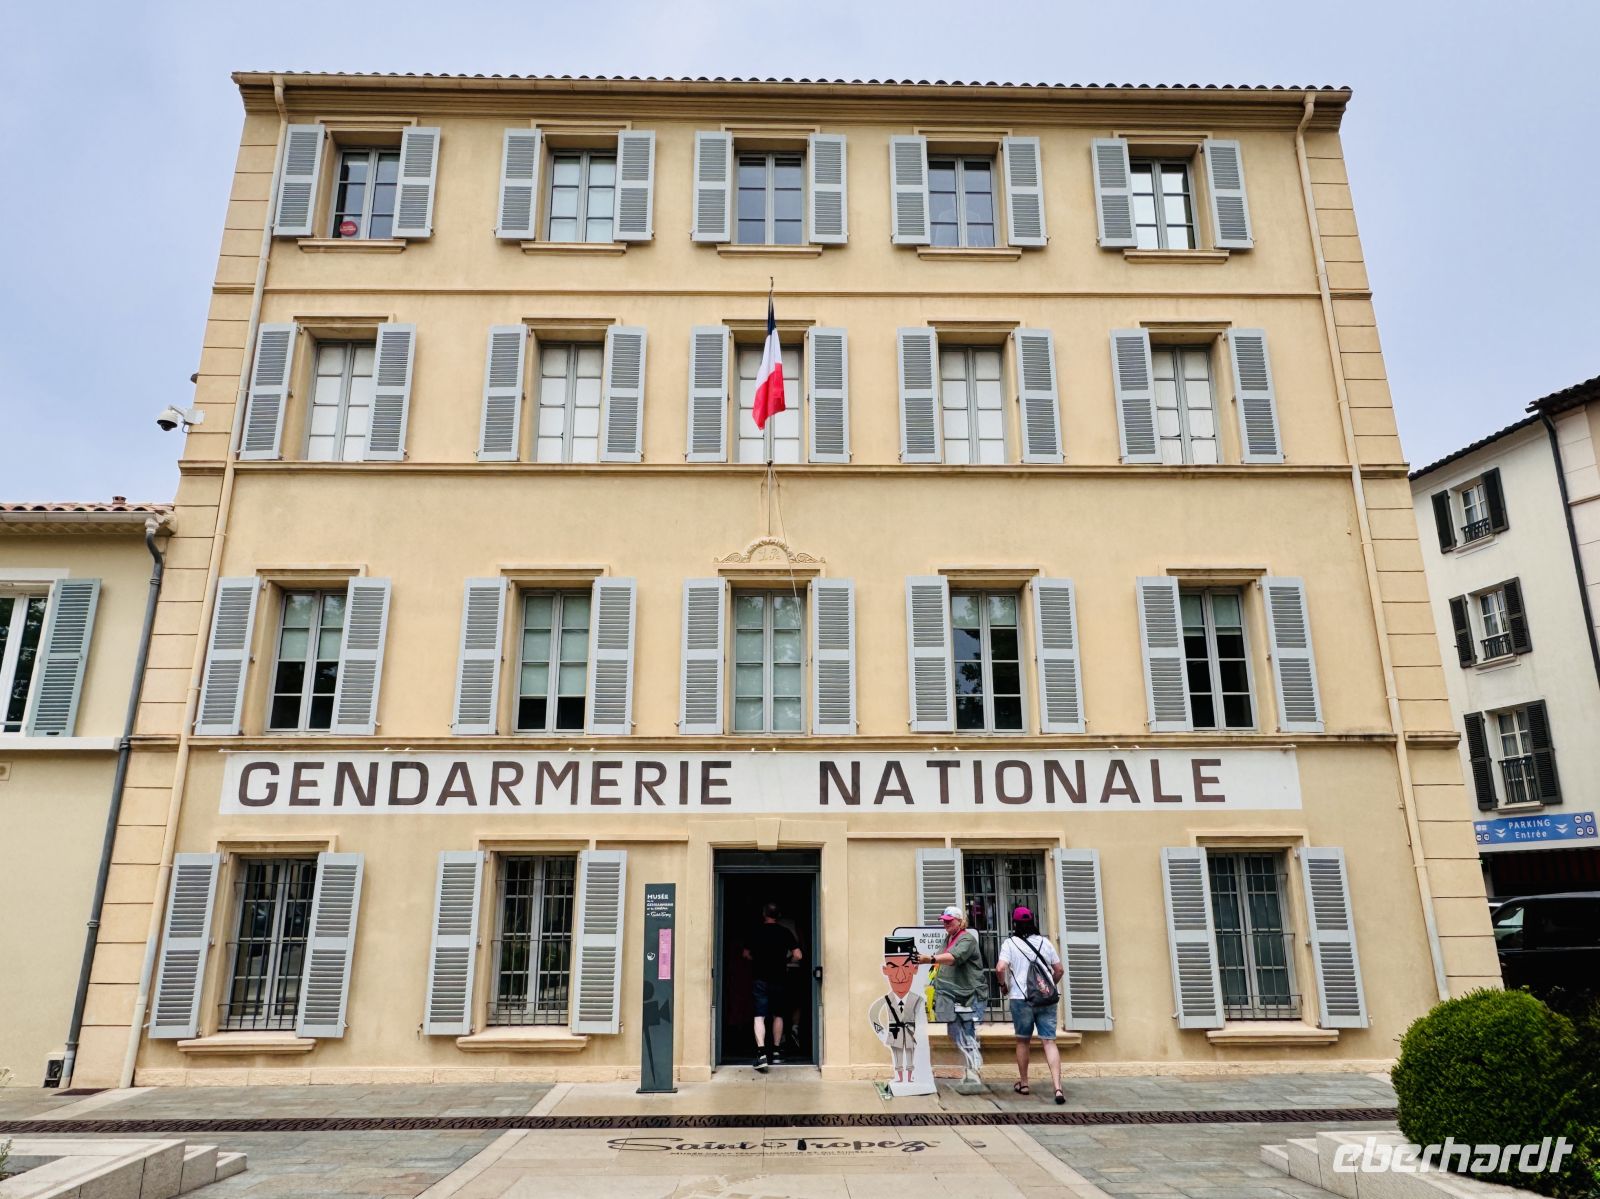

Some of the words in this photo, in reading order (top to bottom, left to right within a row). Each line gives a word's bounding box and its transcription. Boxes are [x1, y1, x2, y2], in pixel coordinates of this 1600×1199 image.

[238, 760, 732, 807] GENDARMERIE
[818, 758, 1226, 805] NATIONALE
[1508, 818, 1552, 830] PARKING
[1515, 830, 1547, 839] Entrée
[607, 1137, 757, 1152] Saint
